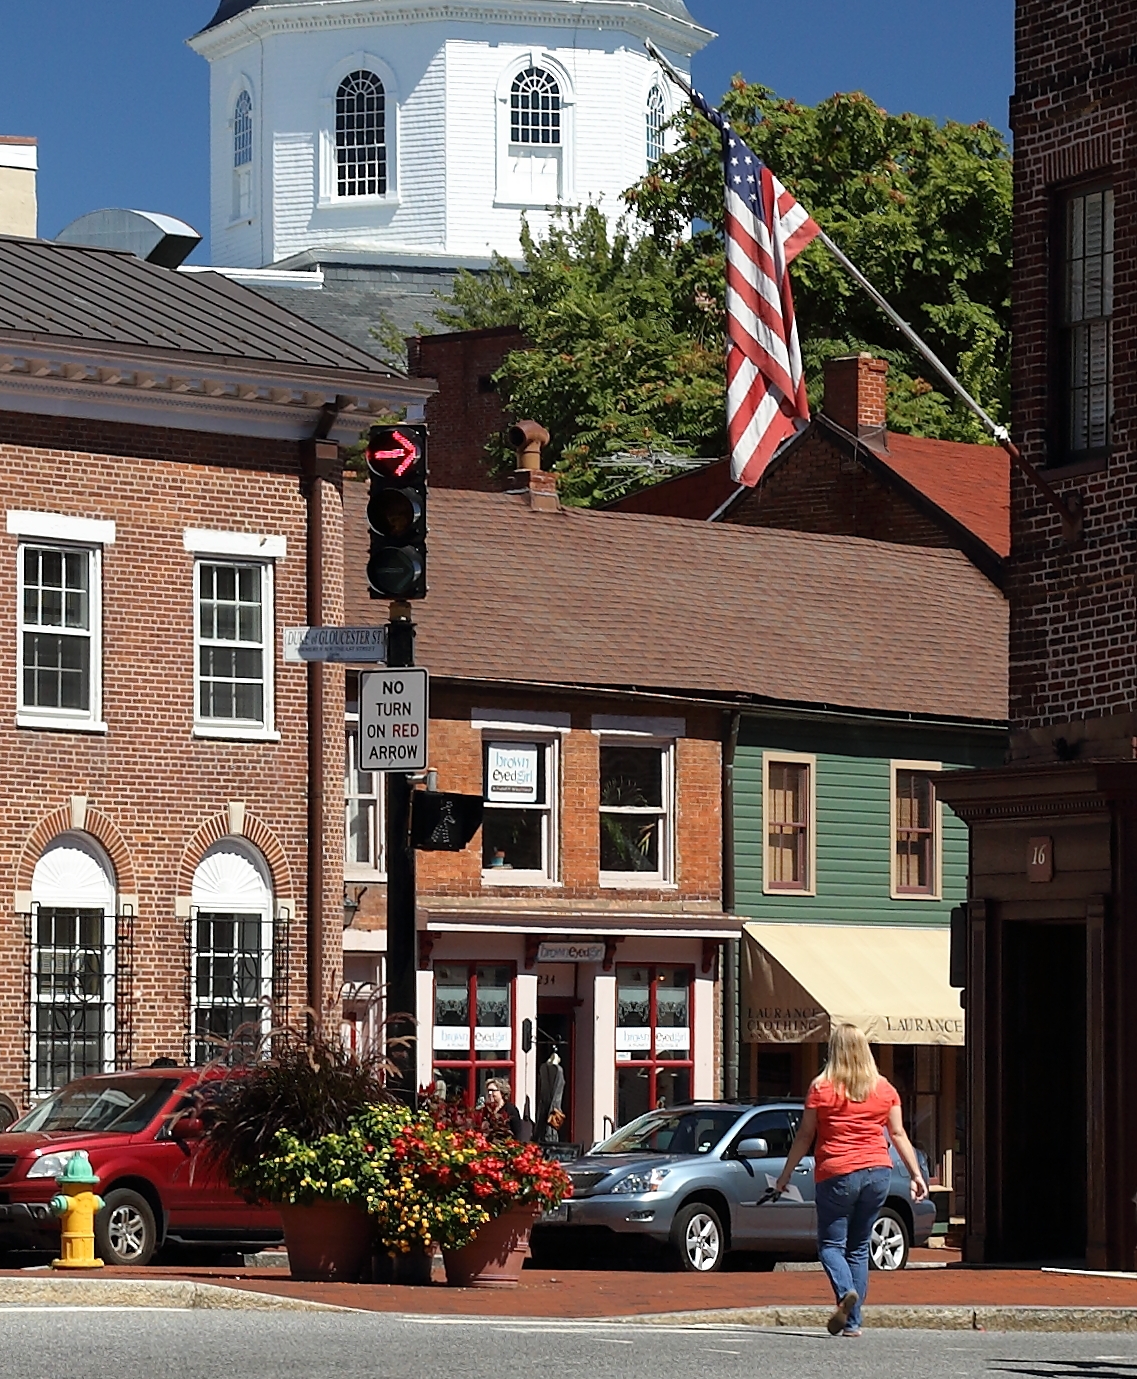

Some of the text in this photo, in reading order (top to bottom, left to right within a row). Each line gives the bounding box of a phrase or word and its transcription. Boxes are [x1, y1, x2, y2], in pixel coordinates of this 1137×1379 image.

[288, 630, 310, 645] DUKE
[318, 630, 370, 645] GLOUCESTER
[382, 680, 404, 694] NO
[375, 702, 411, 716] TURN
[367, 723, 419, 738] ON RED
[369, 745, 417, 760] ARROW
[496, 751, 529, 768] brown
[493, 769, 532, 784] eyedgirl
[1031, 844, 1046, 865] 16
[747, 1007, 819, 1019] LAURANCE
[747, 1020, 817, 1031] CLOTHING
[885, 1016, 963, 1033] LAURANCE
[441, 1029, 468, 1042] brown
